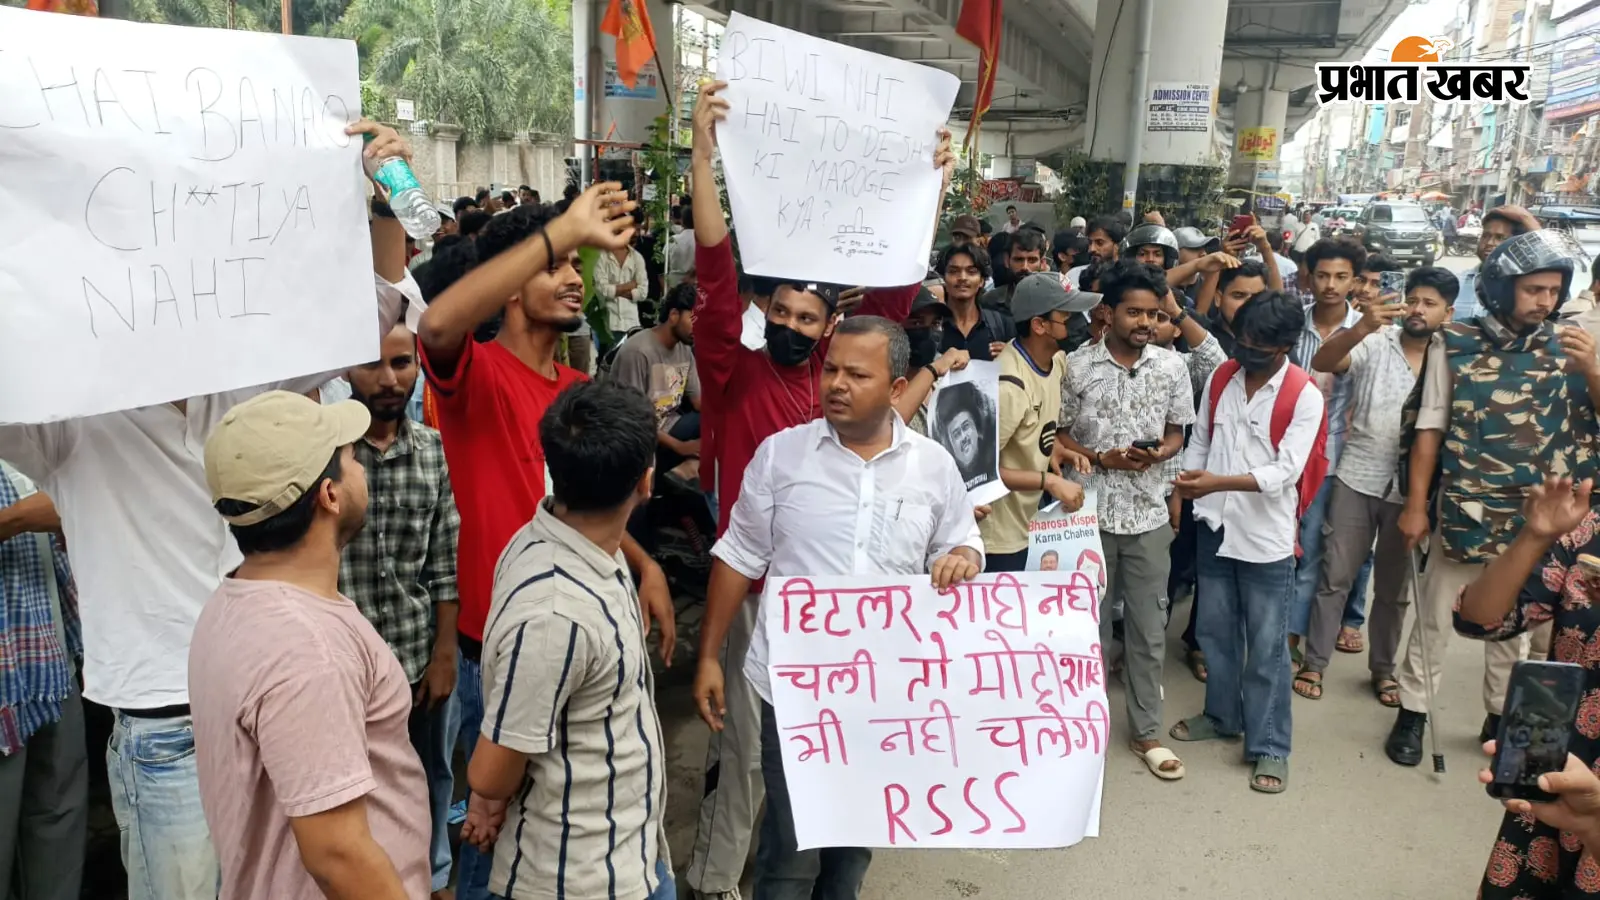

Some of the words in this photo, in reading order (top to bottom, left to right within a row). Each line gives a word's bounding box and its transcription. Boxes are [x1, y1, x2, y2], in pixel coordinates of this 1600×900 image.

[0, 49, 172, 135] HAI
[185, 66, 352, 161] BANAO
[728, 30, 828, 102] BIWI
[843, 63, 905, 122] NHI
[1153, 89, 1191, 100] ADMISSION
[744, 97, 807, 144] HAI
[815, 114, 849, 153] TO
[861, 124, 924, 165] DESH
[752, 148, 784, 180] KI
[806, 159, 900, 203] MAROGE
[82, 256, 272, 339] NAHI
[1028, 518, 1068, 532] Bharosa
[1070, 514, 1097, 527] Kispe
[1035, 532, 1062, 544] Karna
[1064, 527, 1095, 540] Chahea
[778, 577, 922, 643] हिटलर
[936, 572, 1029, 636] शाही
[773, 648, 877, 703] चली
[899, 631, 953, 702] तो
[868, 698, 961, 768] नही
[976, 701, 1111, 766] चलेगी
[883, 771, 1027, 845] RSSS
